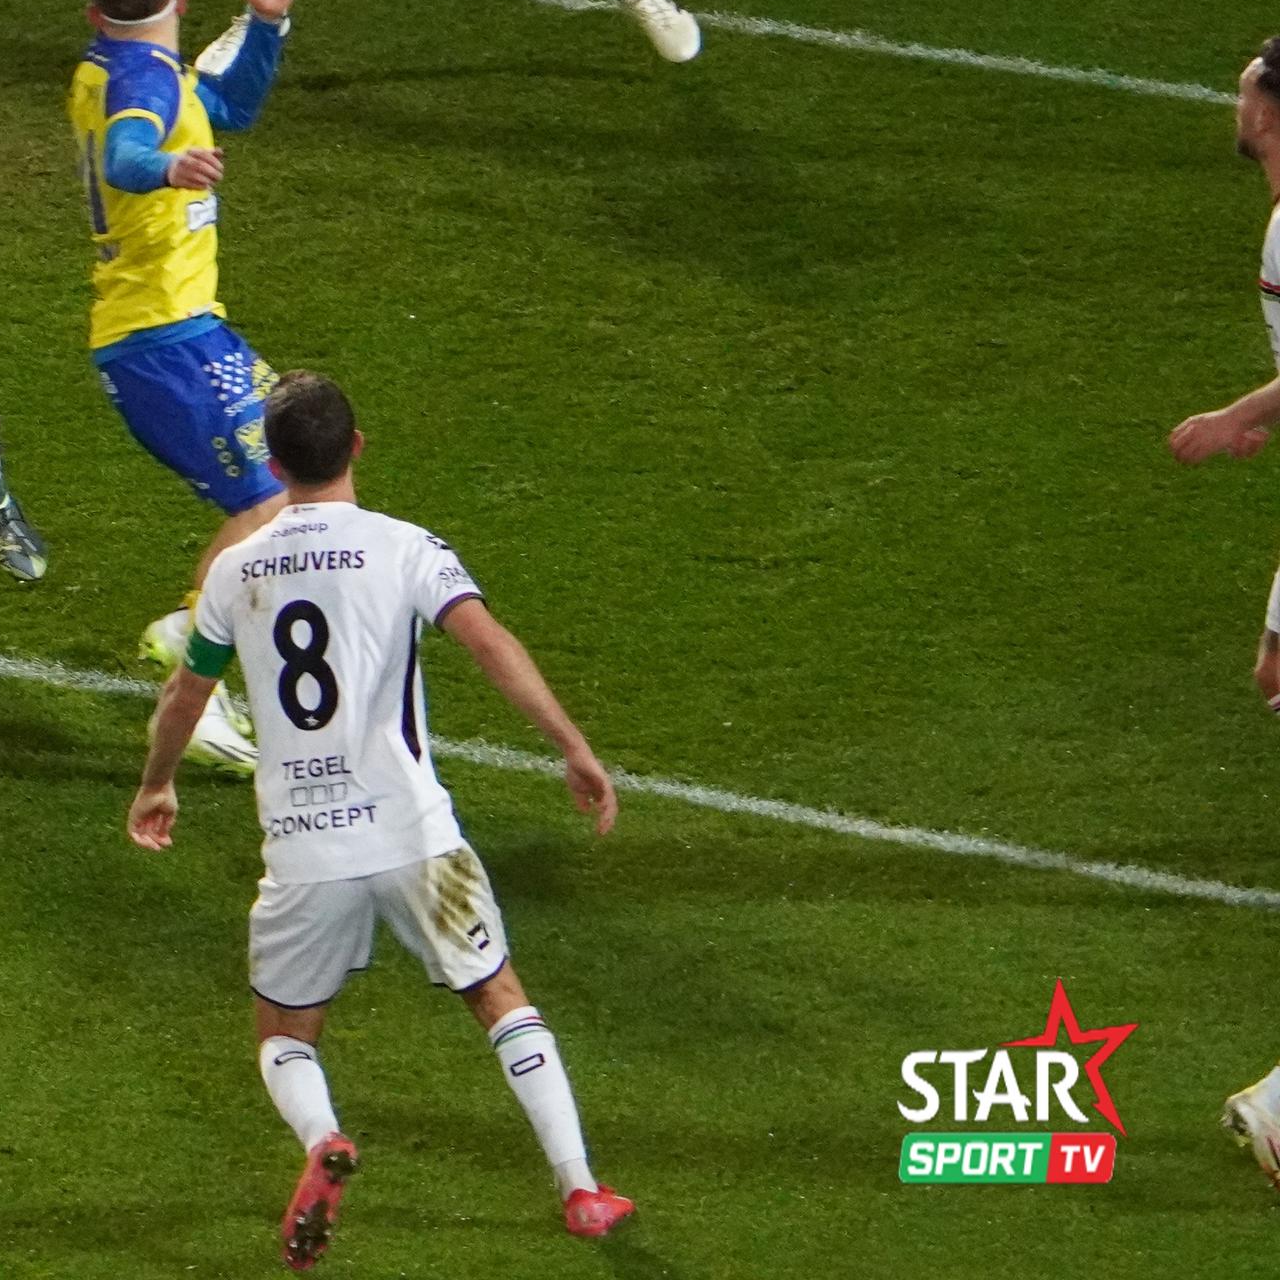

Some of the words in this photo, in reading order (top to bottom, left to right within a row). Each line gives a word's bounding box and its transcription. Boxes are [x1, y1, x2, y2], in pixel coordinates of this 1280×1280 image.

[240, 550, 366, 582] SCHRIJVERS
[273, 599, 339, 730] 8
[282, 755, 351, 780] TEGEL
[270, 805, 377, 837] CONCEPT
